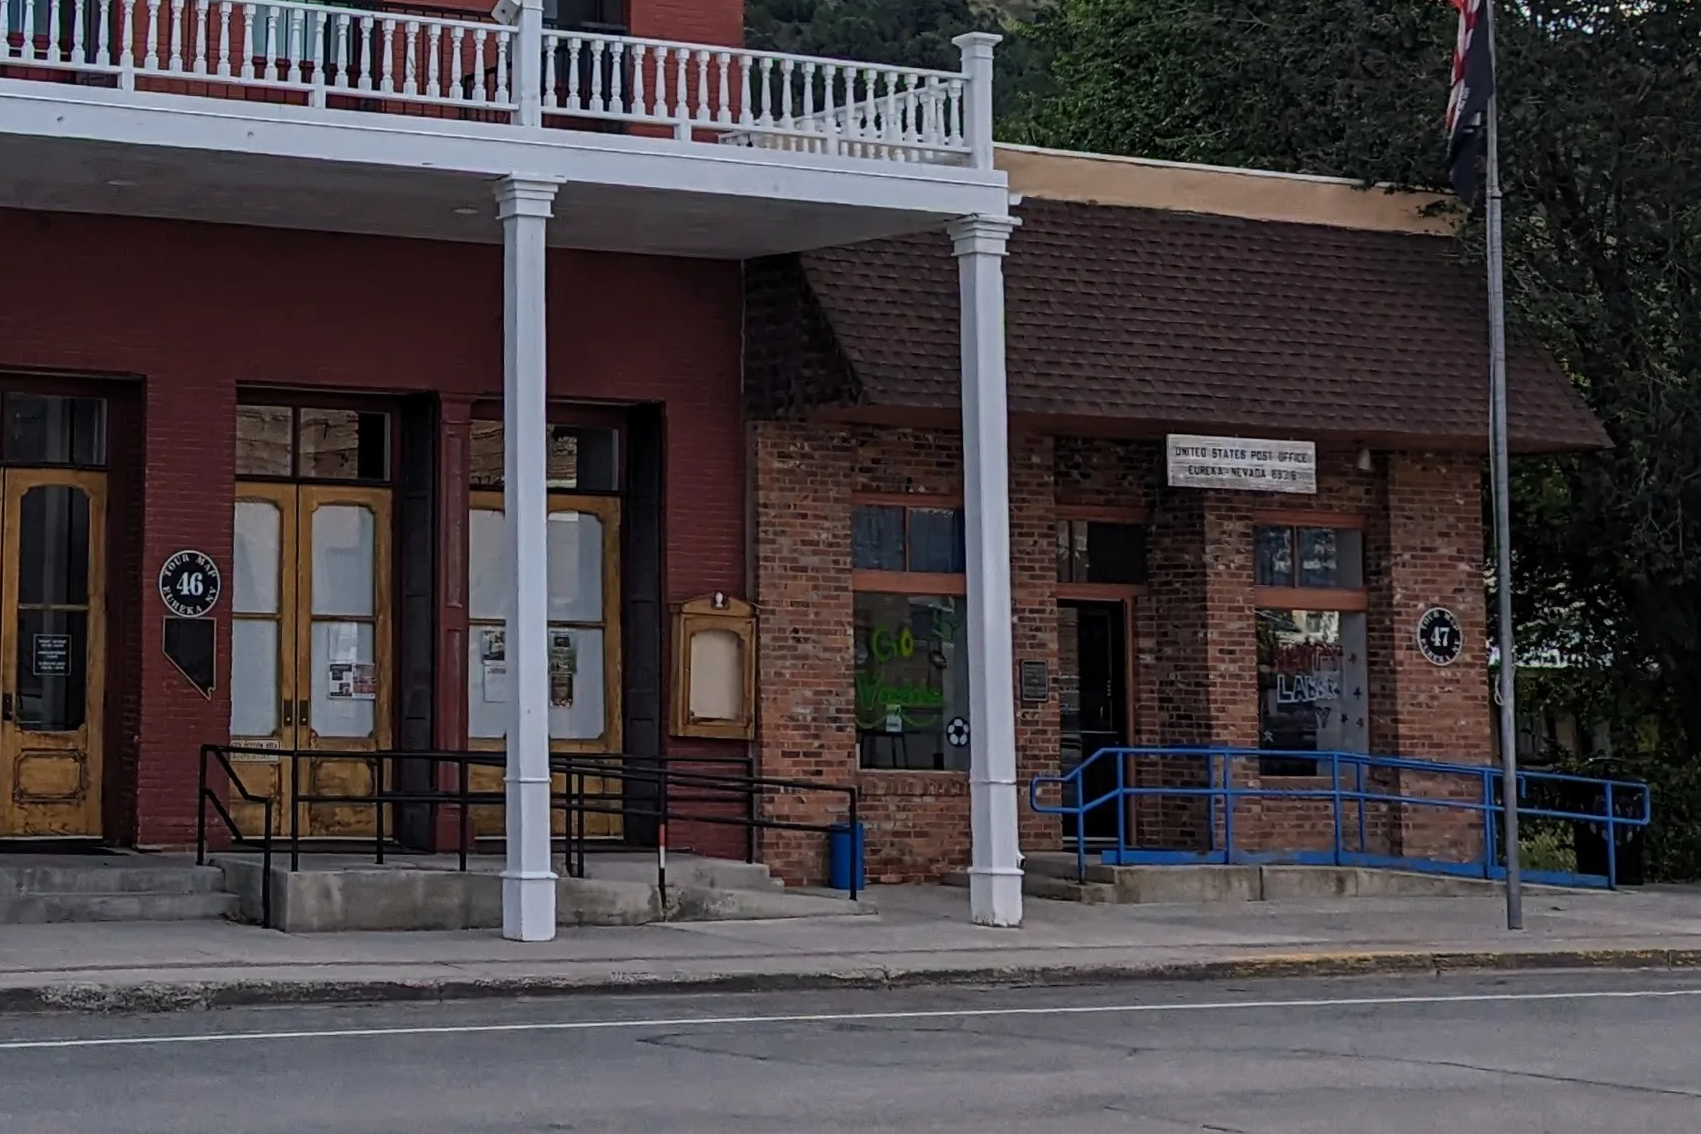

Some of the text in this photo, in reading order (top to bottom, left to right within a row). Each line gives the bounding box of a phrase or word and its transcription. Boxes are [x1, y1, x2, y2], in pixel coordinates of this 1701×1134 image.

[1175, 446, 1308, 463] UNITED STATES POST OFFICE
[163, 553, 218, 578] TOUR MAP
[176, 571, 204, 596] 46
[162, 585, 203, 615] EUREKA
[1430, 626, 1450, 647] 47
